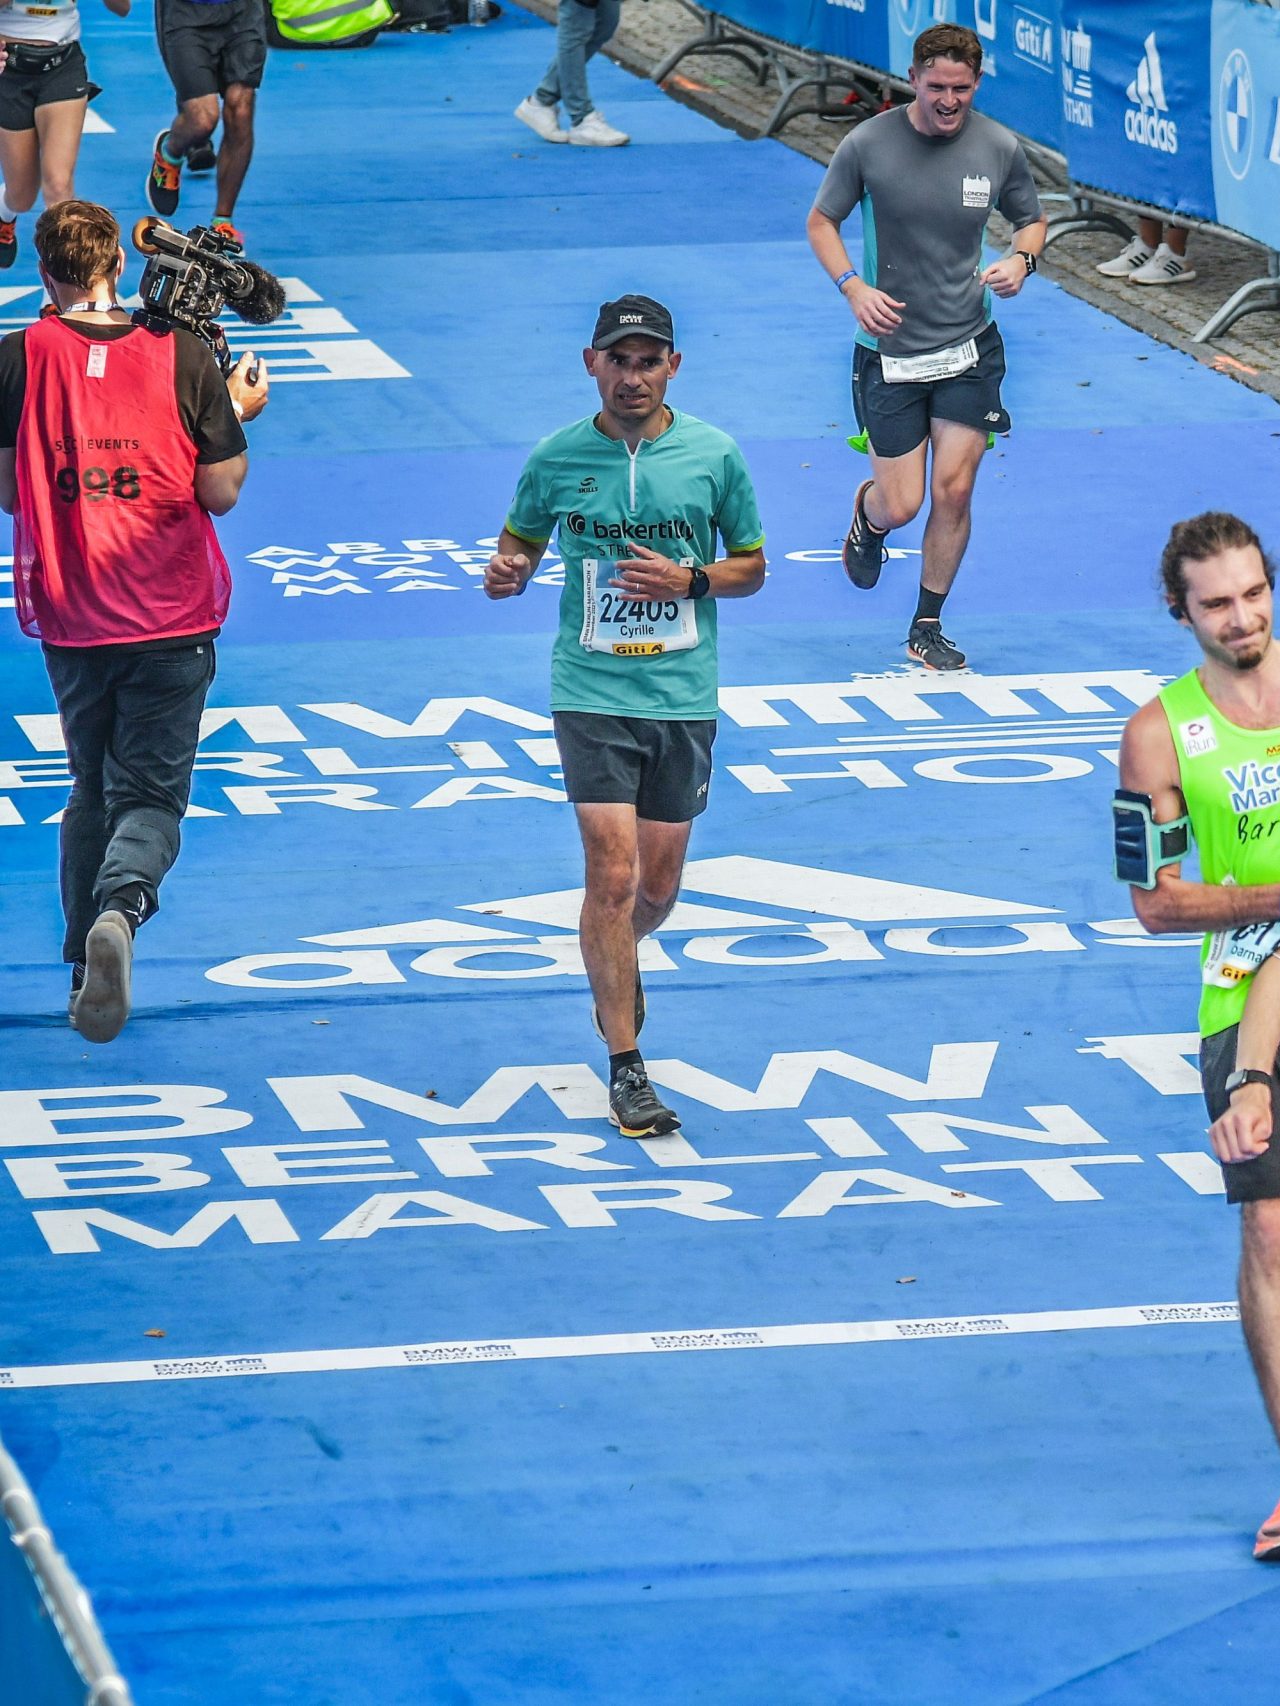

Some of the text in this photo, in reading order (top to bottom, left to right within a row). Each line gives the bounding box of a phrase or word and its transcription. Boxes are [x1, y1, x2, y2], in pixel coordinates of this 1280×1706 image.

[1015, 18, 1041, 58] Giti
[1125, 103, 1177, 154] adidas
[87, 439, 140, 450] EVENTS
[57, 466, 141, 503] 998
[593, 519, 694, 541] bakertilly
[600, 593, 679, 622] 22405
[620, 625, 654, 638] Cyrille
[616, 645, 645, 654] Giti
[1185, 737, 1216, 755] iRun
[1222, 968, 1247, 980] Gi
[0, 1041, 998, 1147] BMW
[3, 1105, 1109, 1199] BERLIN
